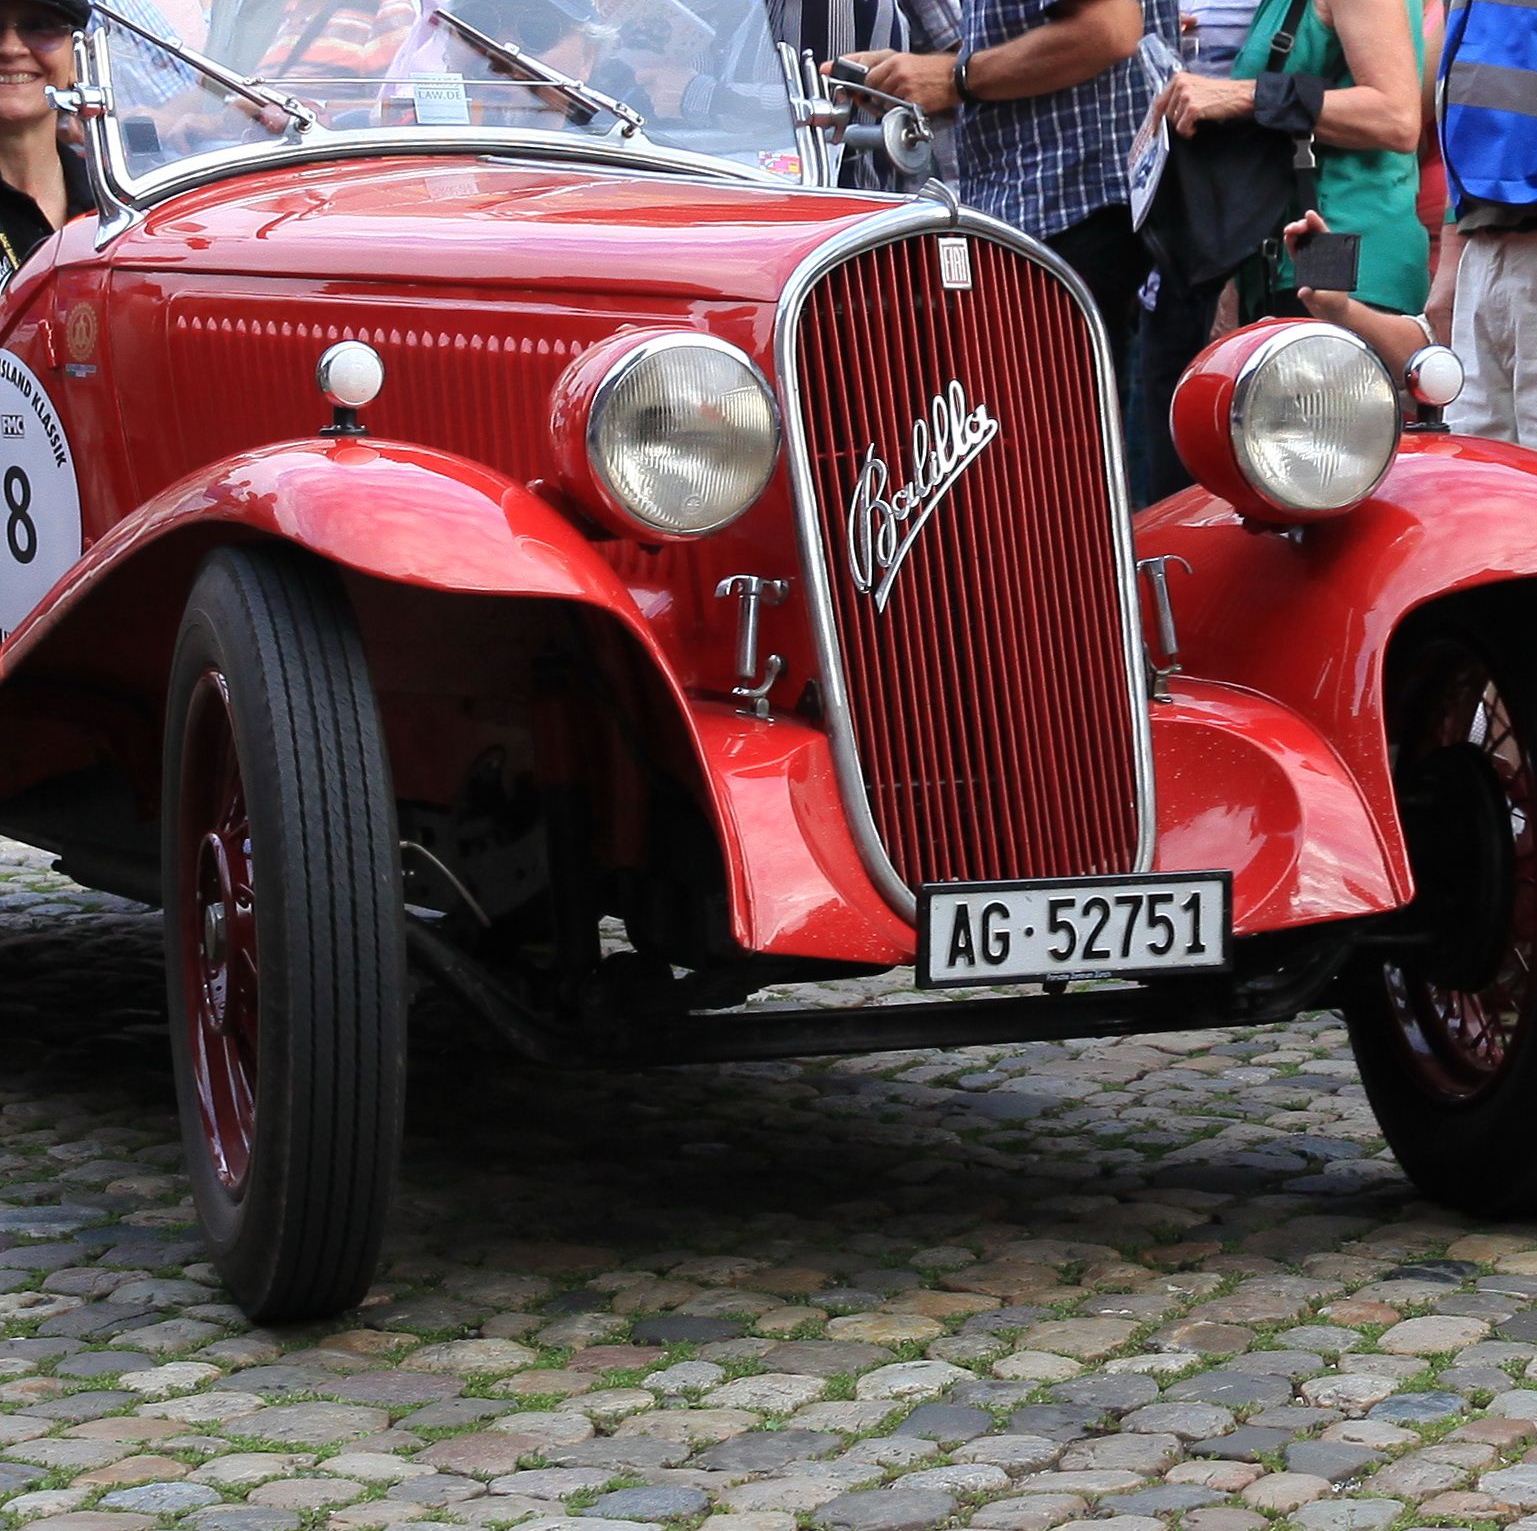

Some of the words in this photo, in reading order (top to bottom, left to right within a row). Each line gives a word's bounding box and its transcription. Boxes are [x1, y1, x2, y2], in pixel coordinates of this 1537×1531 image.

[943, 247, 970, 281] FIAT
[31, 391, 67, 469] KLASSIK
[848, 379, 998, 614] Balilla
